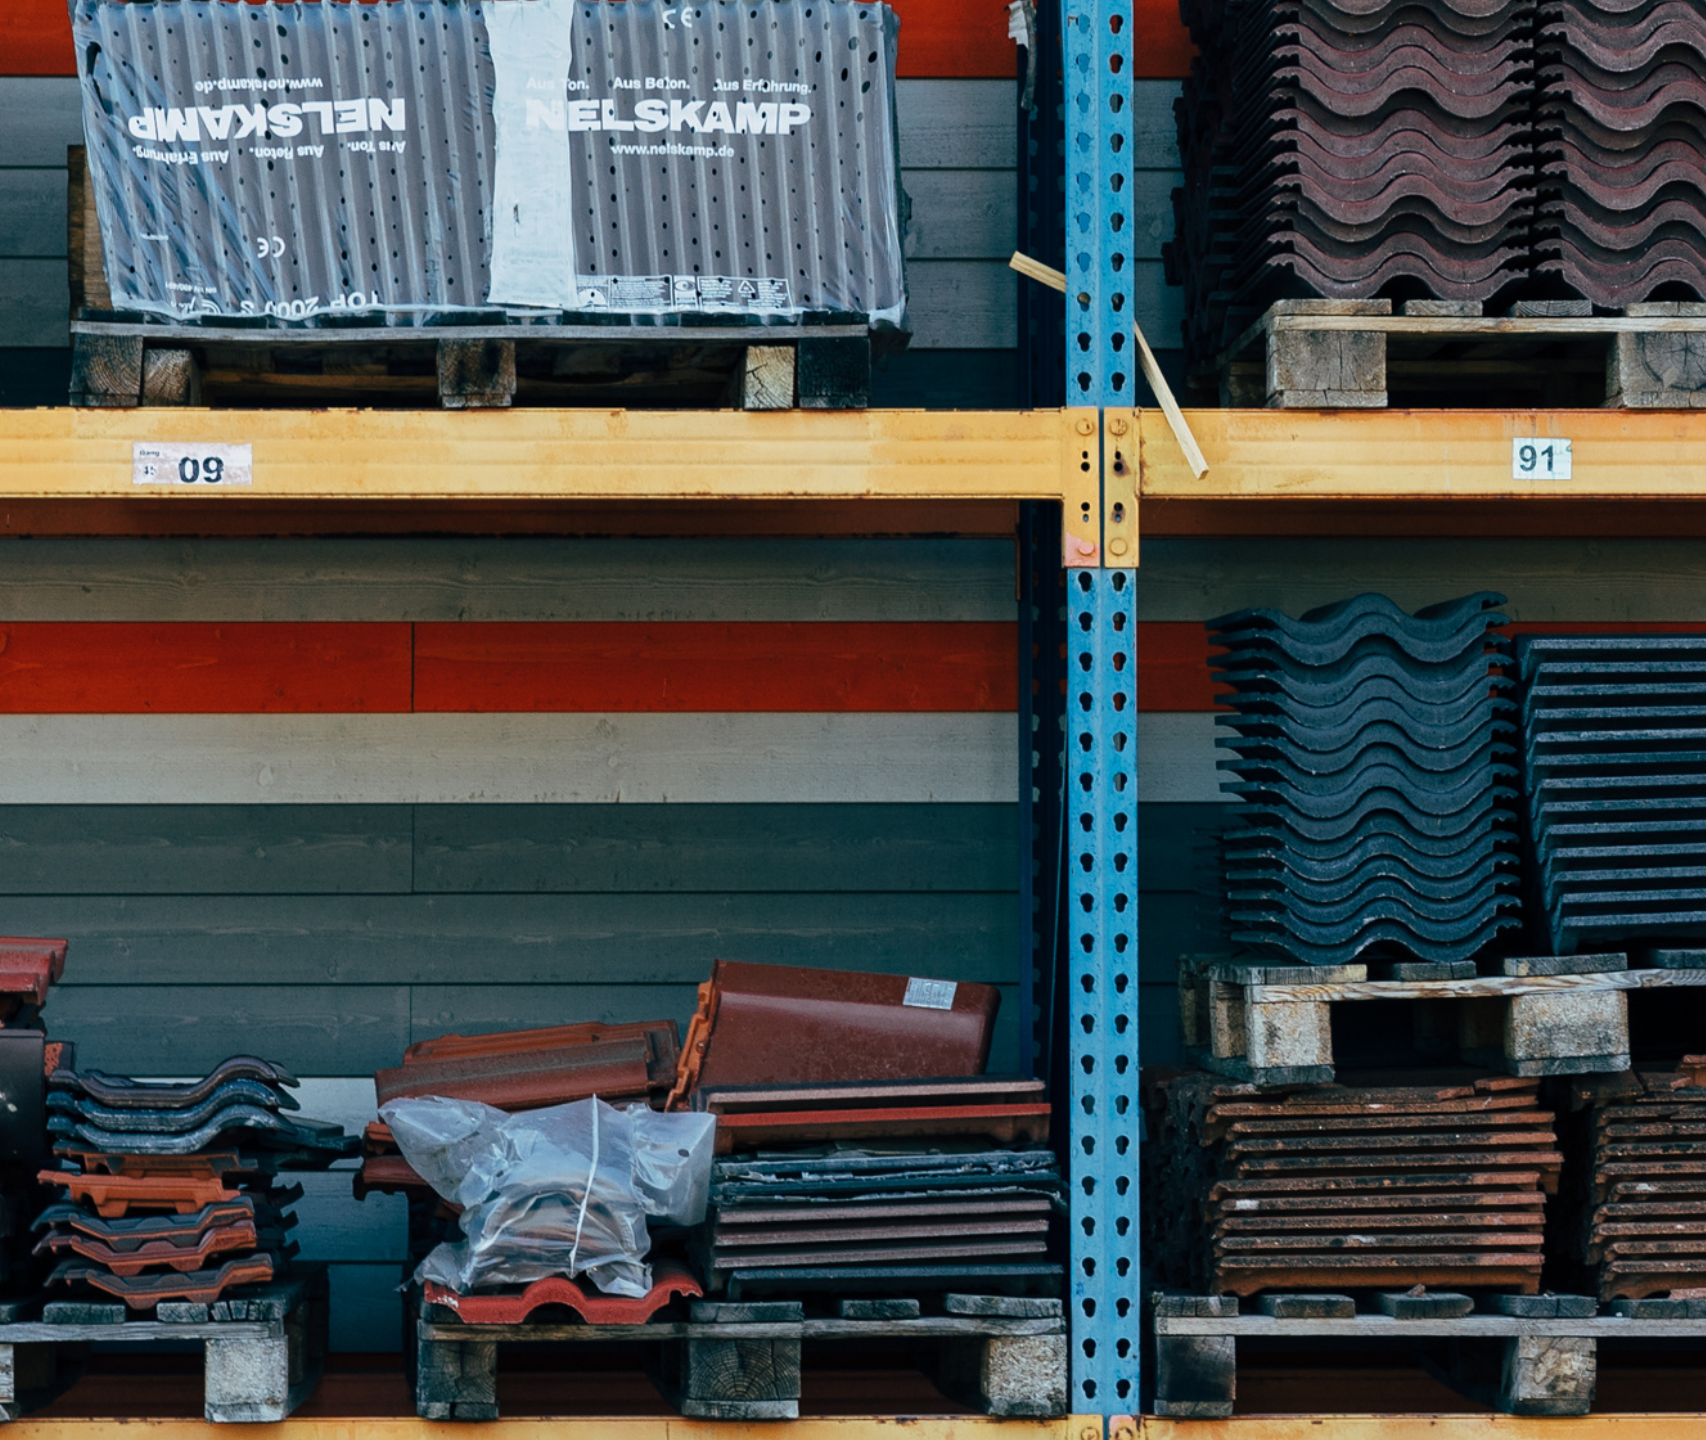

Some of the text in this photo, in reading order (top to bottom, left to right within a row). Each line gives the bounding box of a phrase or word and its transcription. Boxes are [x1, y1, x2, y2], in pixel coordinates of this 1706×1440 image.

[194, 76, 324, 94] www.nelskamp.de
[612, 76, 642, 91] Aus
[644, 75, 691, 91] Beton.
[128, 98, 406, 143] NELSKAMP
[524, 98, 812, 136] NELSKAMP
[132, 145, 199, 165] Erfahrung.
[296, 144, 325, 159] Aus
[347, 140, 376, 153] Ton.
[611, 144, 735, 159] www.nelskamp.de
[201, 148, 230, 164] Aus
[1519, 444, 1554, 472] 91
[178, 456, 224, 483] 09
